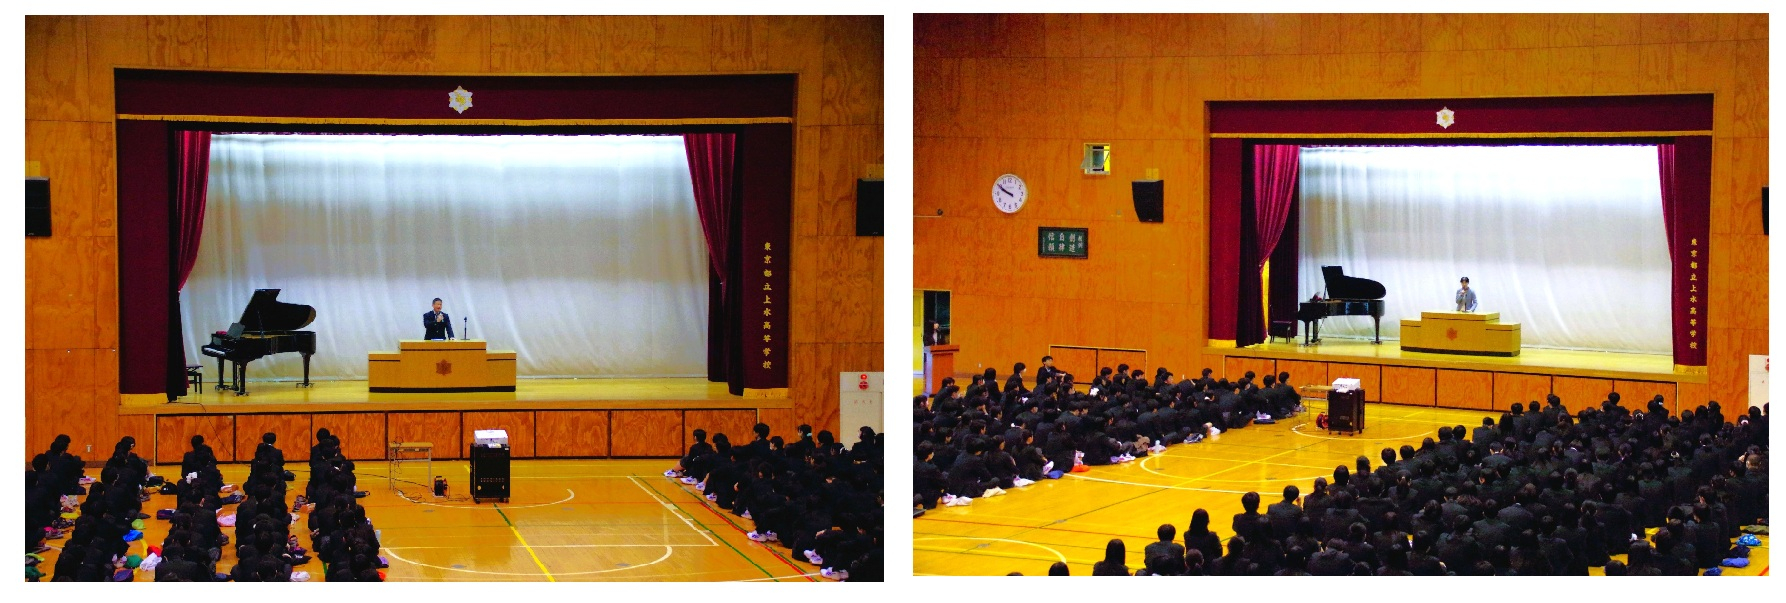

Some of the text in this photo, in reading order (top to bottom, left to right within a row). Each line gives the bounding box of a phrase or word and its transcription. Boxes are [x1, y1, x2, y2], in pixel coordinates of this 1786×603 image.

[762, 241, 773, 370] 東京都立上水高等学校
[1689, 238, 1698, 350] 東京都立上水高等学校
